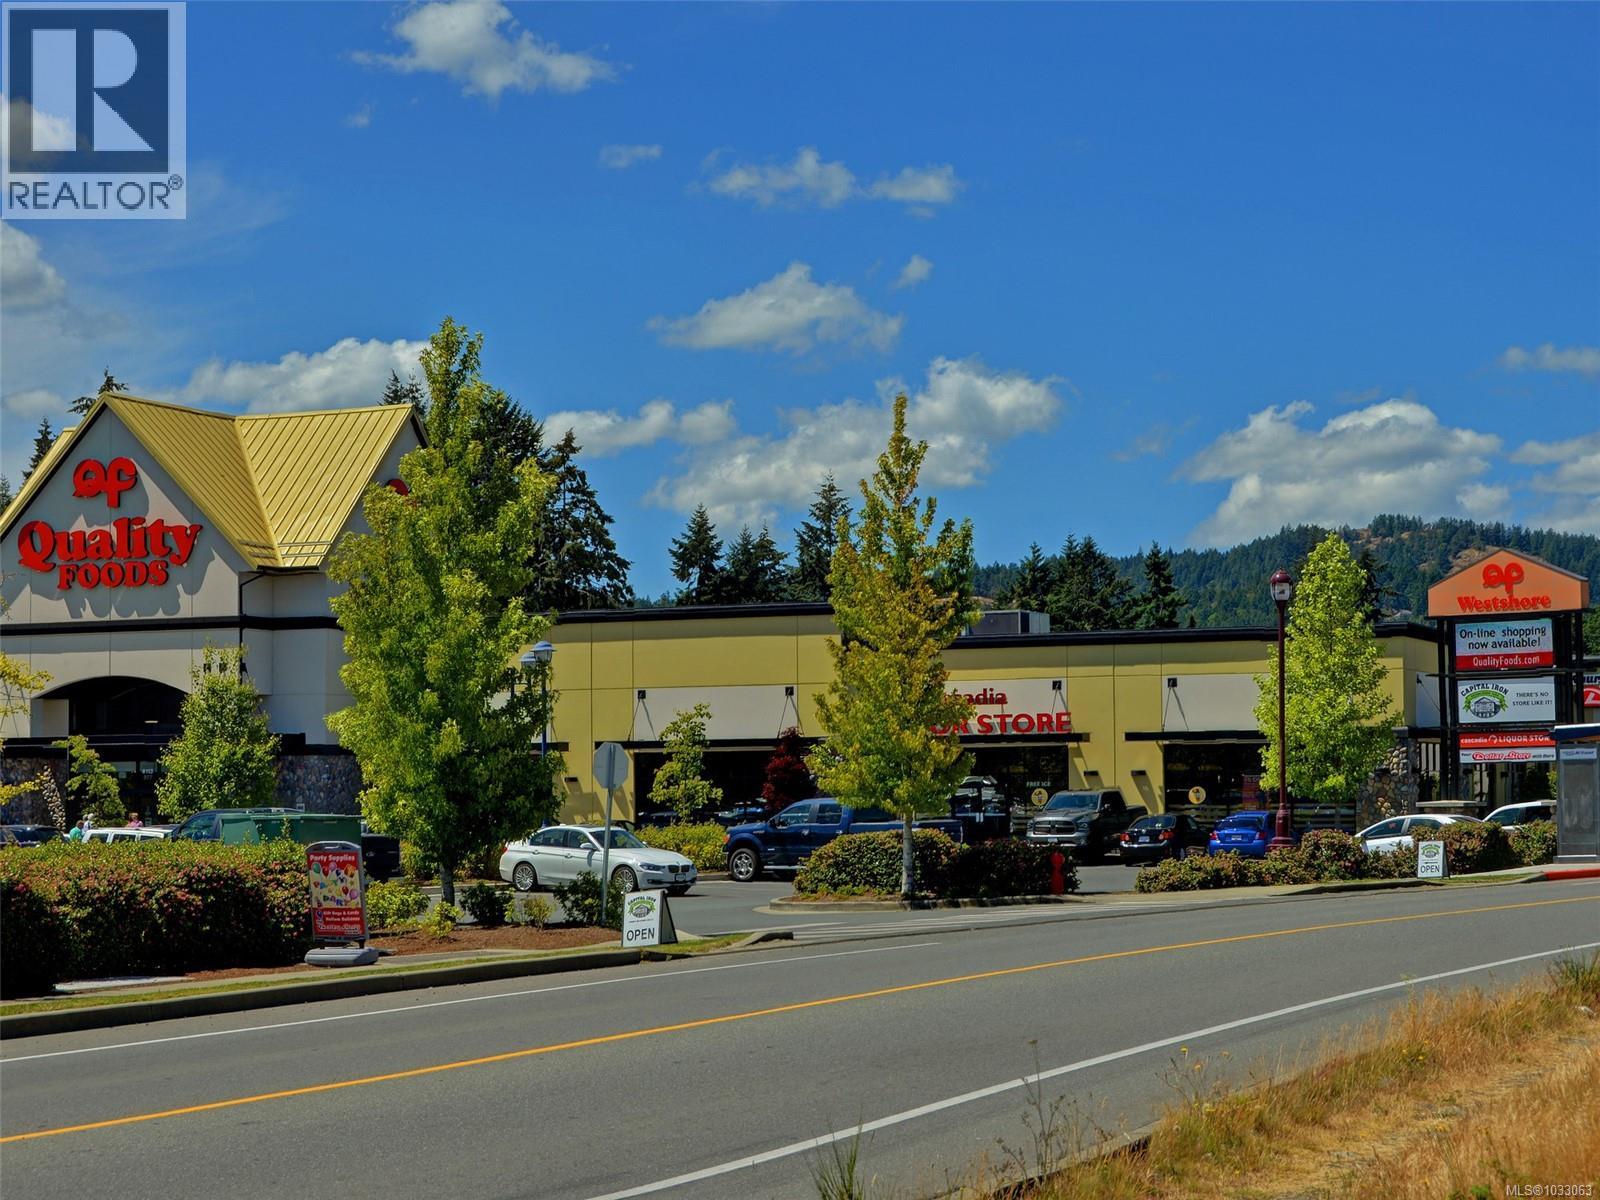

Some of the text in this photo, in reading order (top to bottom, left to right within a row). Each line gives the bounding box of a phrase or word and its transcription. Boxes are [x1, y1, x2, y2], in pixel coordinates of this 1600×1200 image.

[17, 516, 204, 573] Quality
[57, 559, 170, 591] FOODS
[1457, 594, 1551, 613] Westshore
[1459, 626, 1547, 639] On-line shopping
[1468, 637, 1541, 650] now available!
[1473, 655, 1540, 668] QualityFoods.com
[1460, 683, 1489, 696] CAPITAL
[1491, 683, 1509, 695] IRON
[977, 712, 1071, 733] STORE
[1498, 735, 1528, 743] LIQUOR
[1472, 752, 1505, 760] Dollar
[328, 854, 355, 862] Supplies
[627, 928, 655, 941] OPEN
